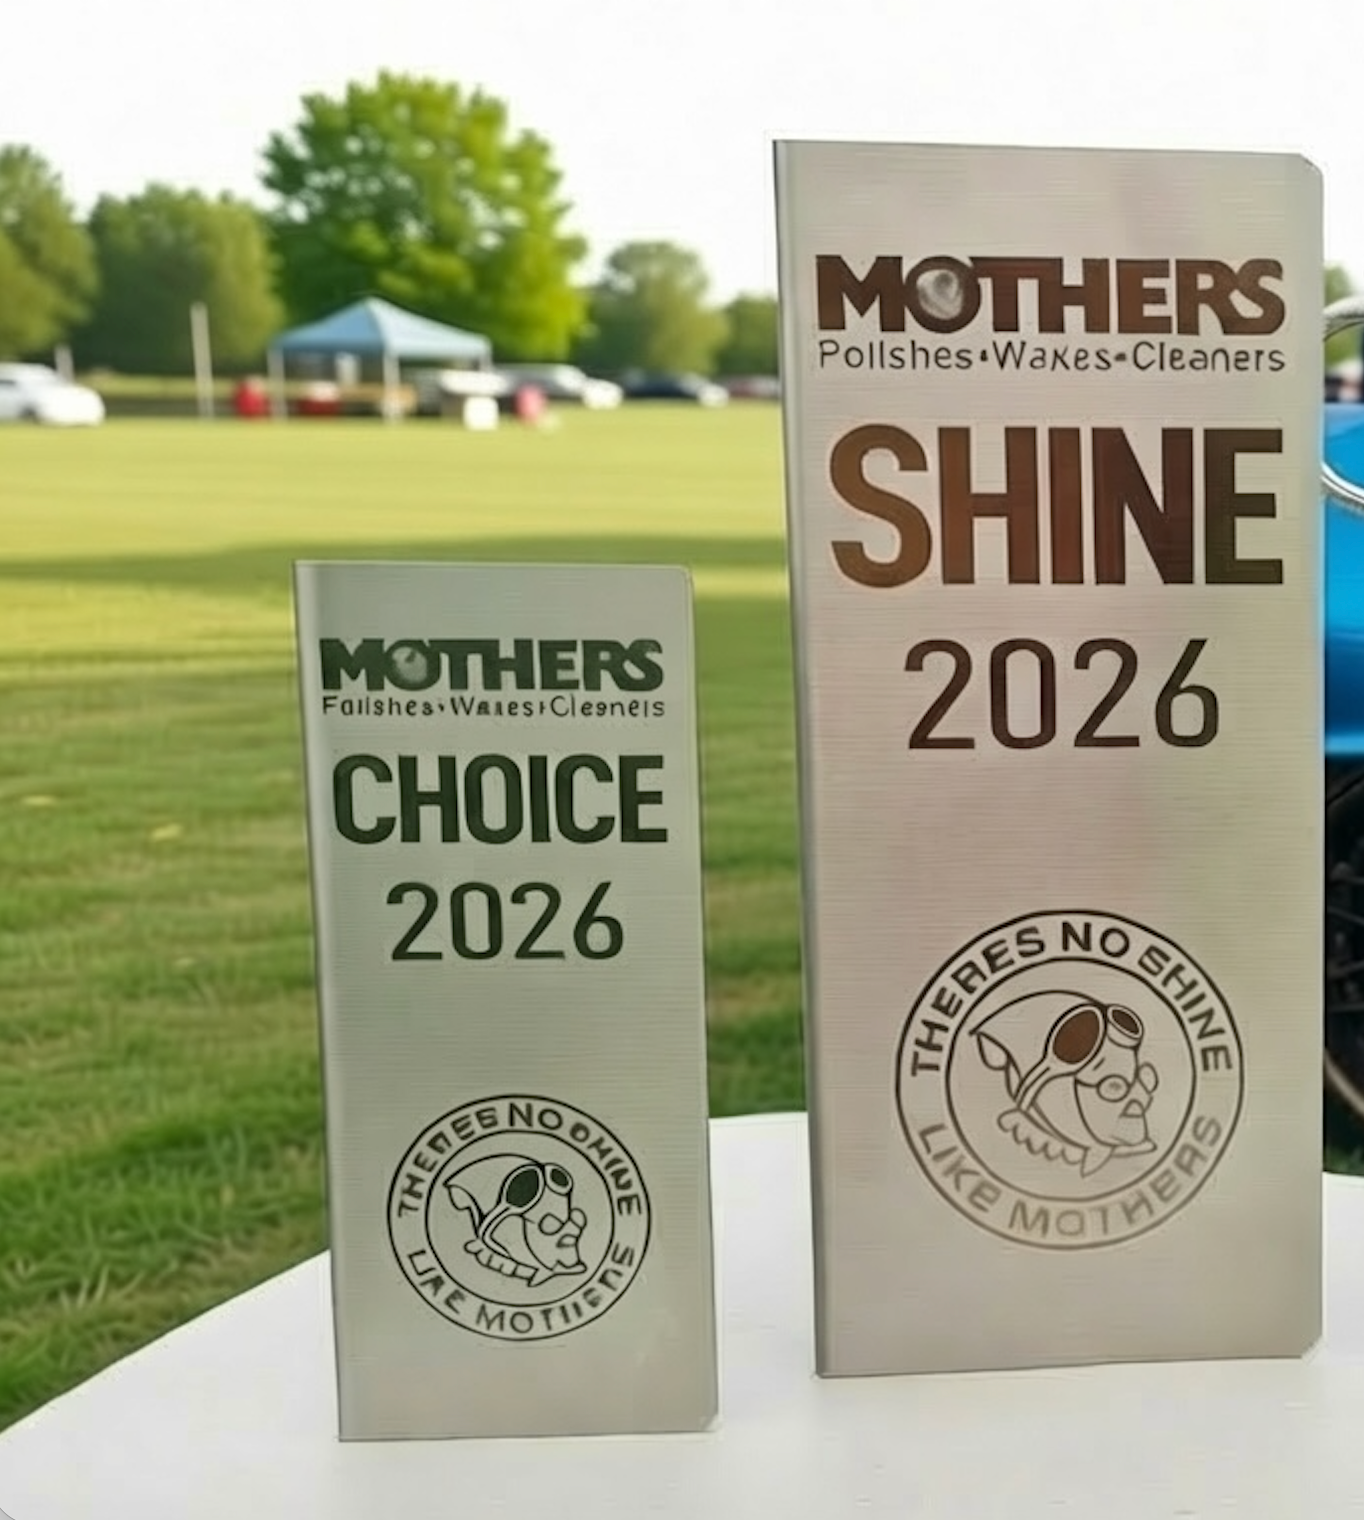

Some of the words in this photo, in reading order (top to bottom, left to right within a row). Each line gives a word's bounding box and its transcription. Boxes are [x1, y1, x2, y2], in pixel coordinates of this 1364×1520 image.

[815, 254, 1286, 336] MOTHERS
[829, 423, 1284, 589] SHINE
[318, 637, 664, 692] MOTHERS
[904, 637, 1219, 750] 2026
[332, 753, 668, 845] CHOICE
[386, 881, 624, 961] 2026
[911, 926, 1045, 1077] THERES
[1061, 921, 1131, 959] NO
[1137, 945, 1233, 1072] SHINE
[508, 1102, 563, 1131] NO
[917, 1122, 1001, 1214] LIKE
